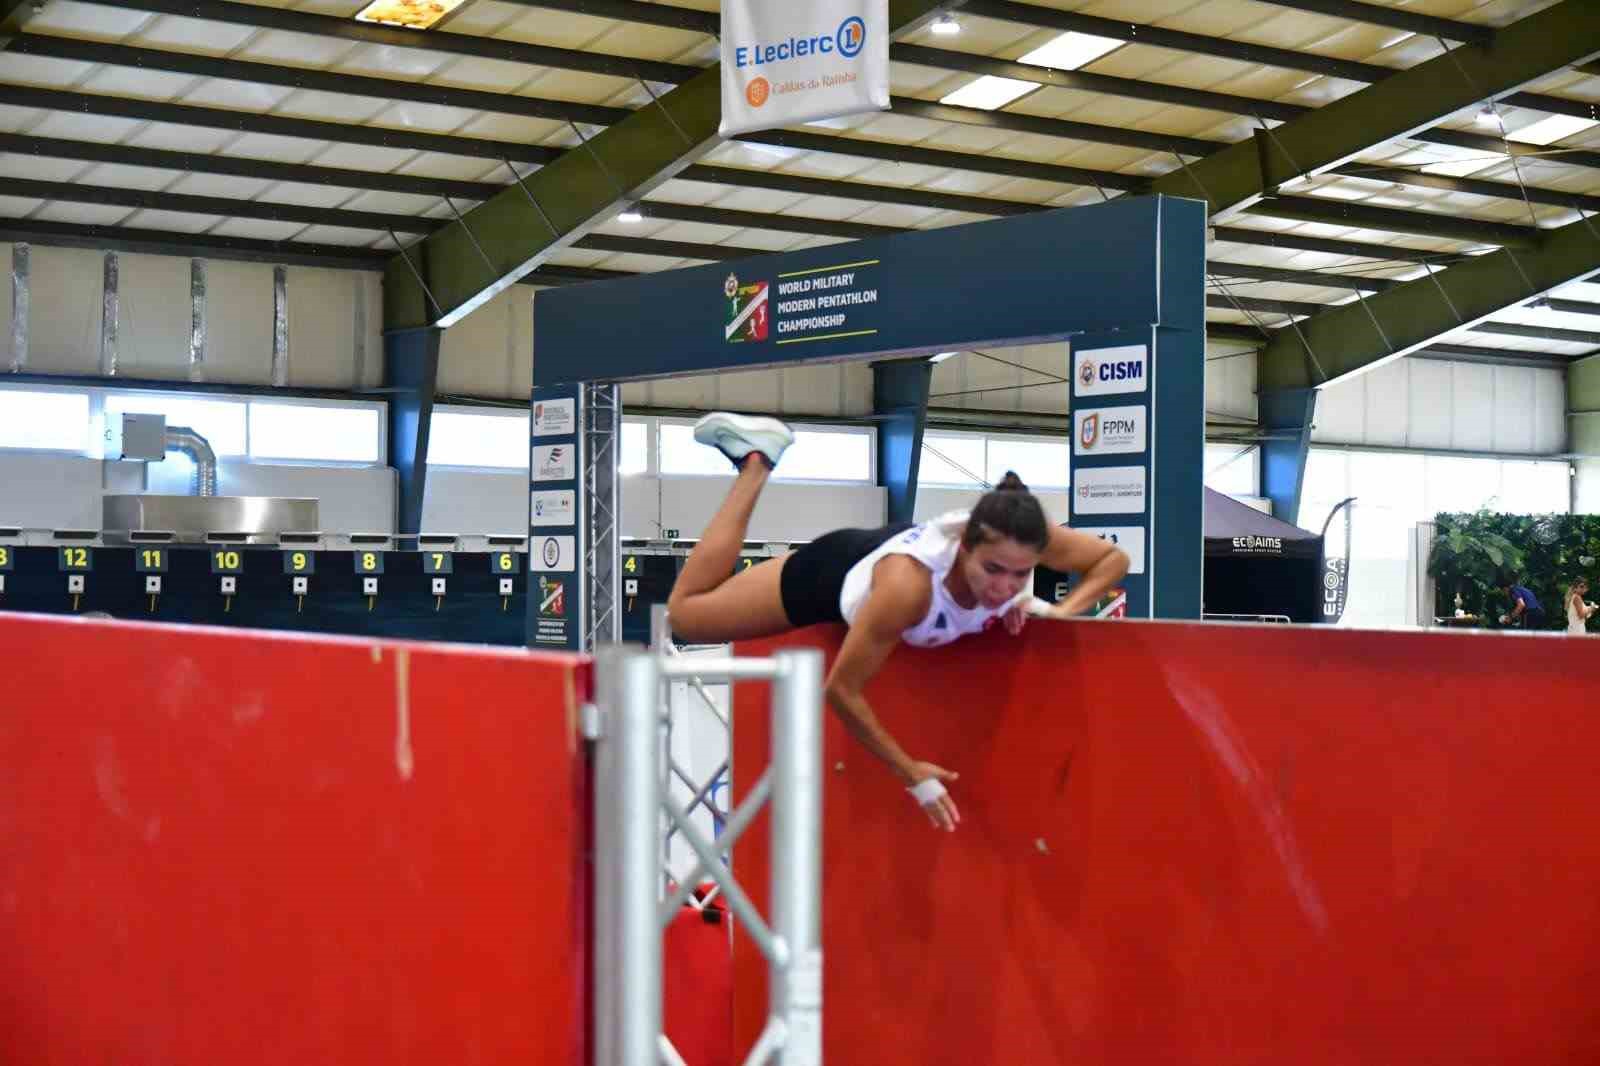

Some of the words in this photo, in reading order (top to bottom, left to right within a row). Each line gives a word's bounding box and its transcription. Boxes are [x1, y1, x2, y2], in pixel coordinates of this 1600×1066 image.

[736, 35, 834, 68] E.Leclerc
[778, 280, 811, 295] WORLD
[812, 273, 855, 291] MILITARY
[777, 298, 816, 314] MODERN
[817, 289, 878, 309] PENTATHLON
[777, 314, 846, 333] CHAMPIONSHIP
[1099, 360, 1143, 381] CISM
[1103, 419, 1135, 434] FPPM
[64, 548, 87, 566] 12
[142, 550, 161, 568] 11
[215, 551, 240, 569] 10
[292, 552, 306, 570] 9
[362, 552, 376, 570] 8
[432, 553, 444, 570] 7
[500, 553, 512, 570] 6
[624, 556, 636, 573] 4
